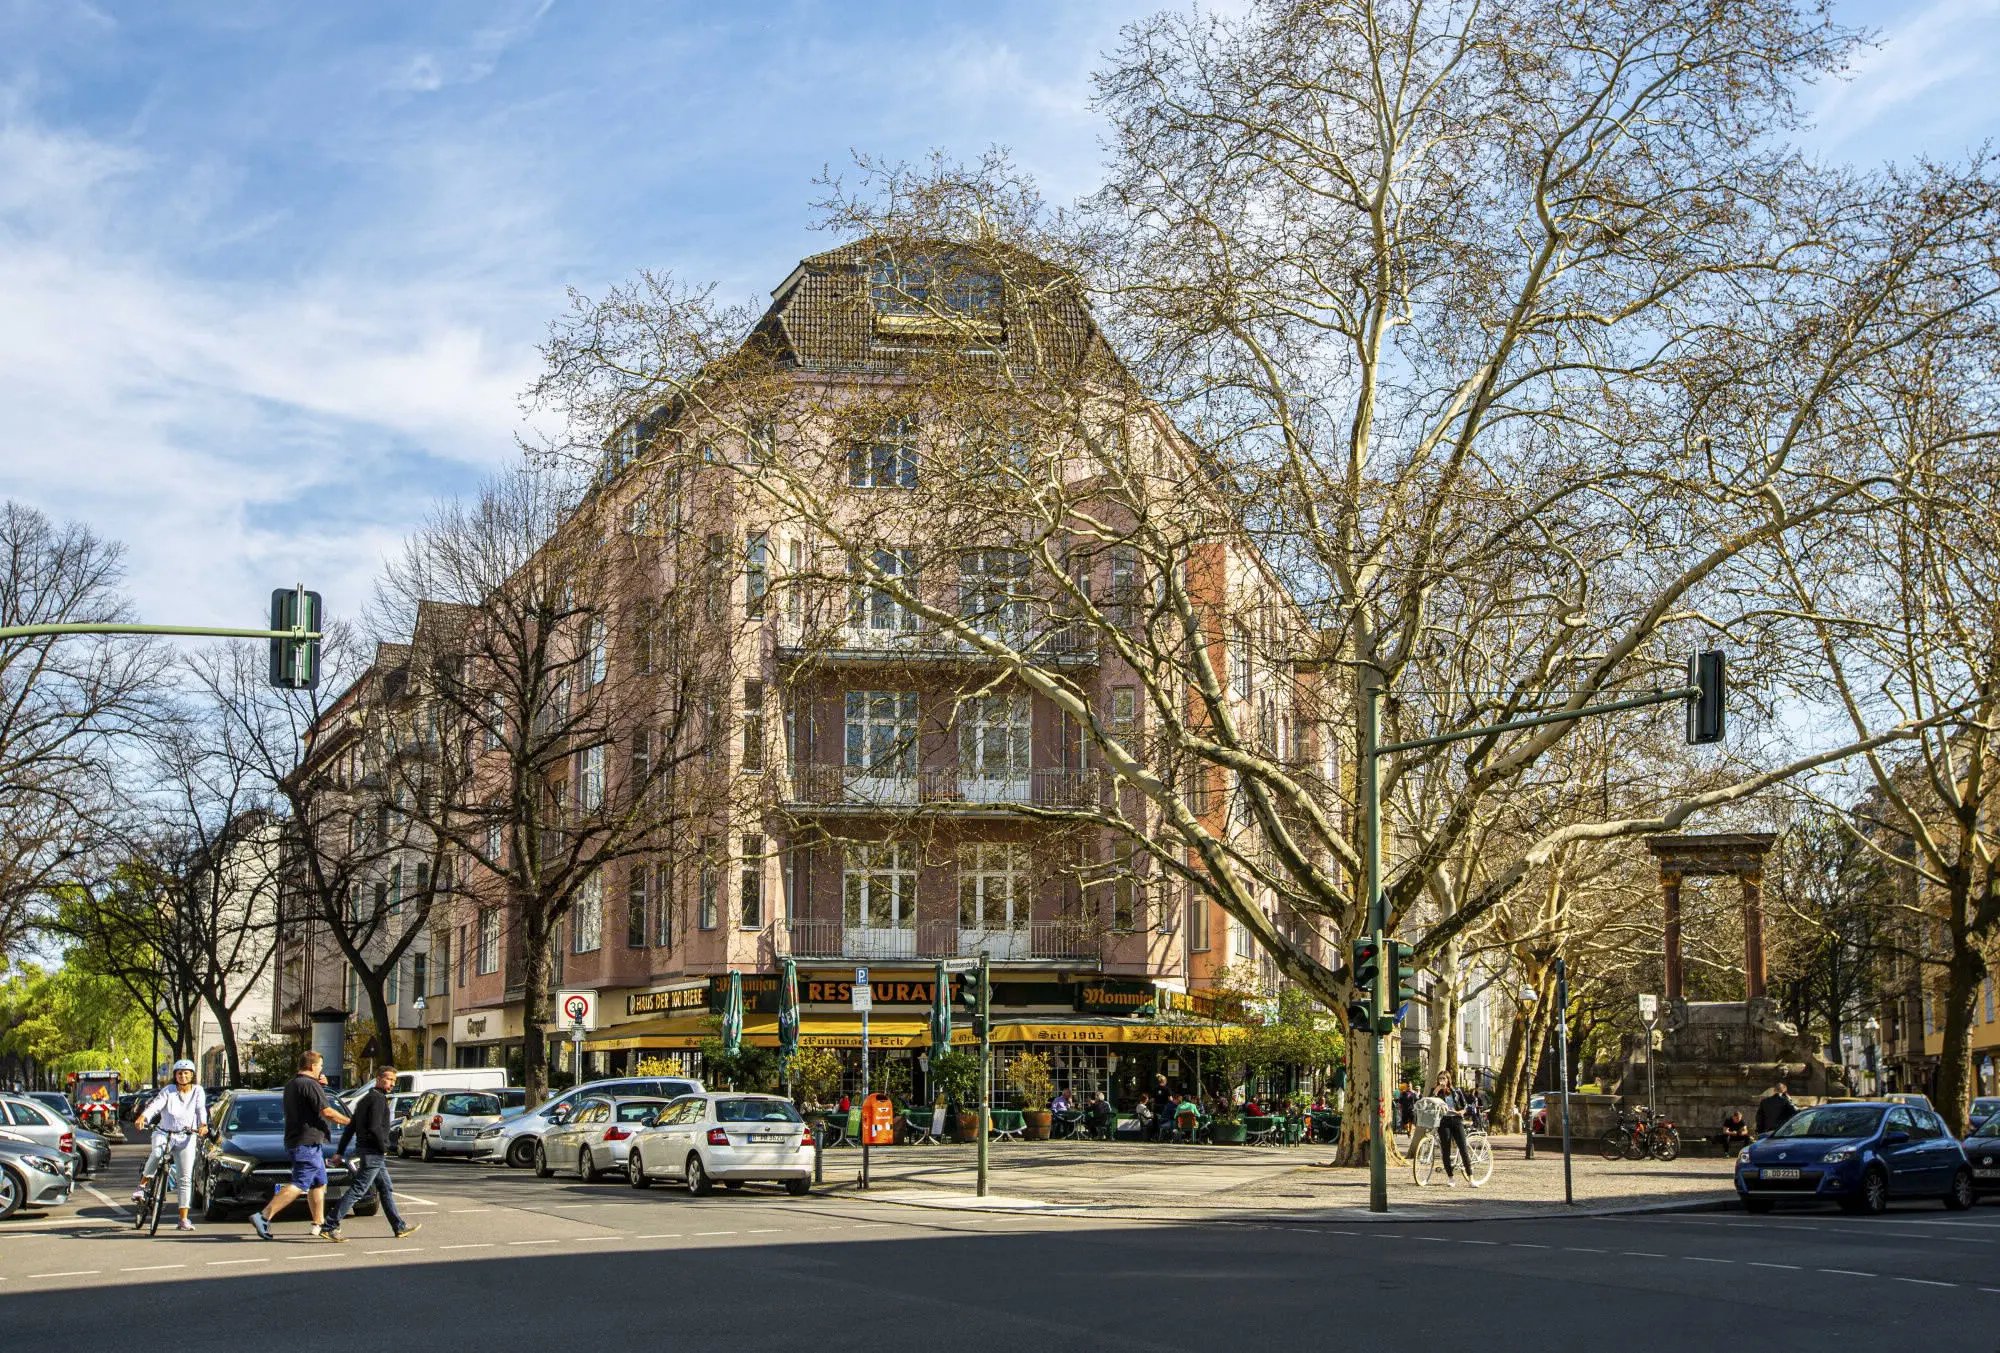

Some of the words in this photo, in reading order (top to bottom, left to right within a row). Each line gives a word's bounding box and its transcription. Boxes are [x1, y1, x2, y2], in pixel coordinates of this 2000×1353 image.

[636, 995, 654, 1011] HAUS
[655, 992, 669, 1009] DER
[671, 991, 683, 1008] 100
[683, 988, 703, 1006] BIERE
[1037, 1030, 1067, 1040] Seit
[1072, 1031, 1104, 1040] 1905
